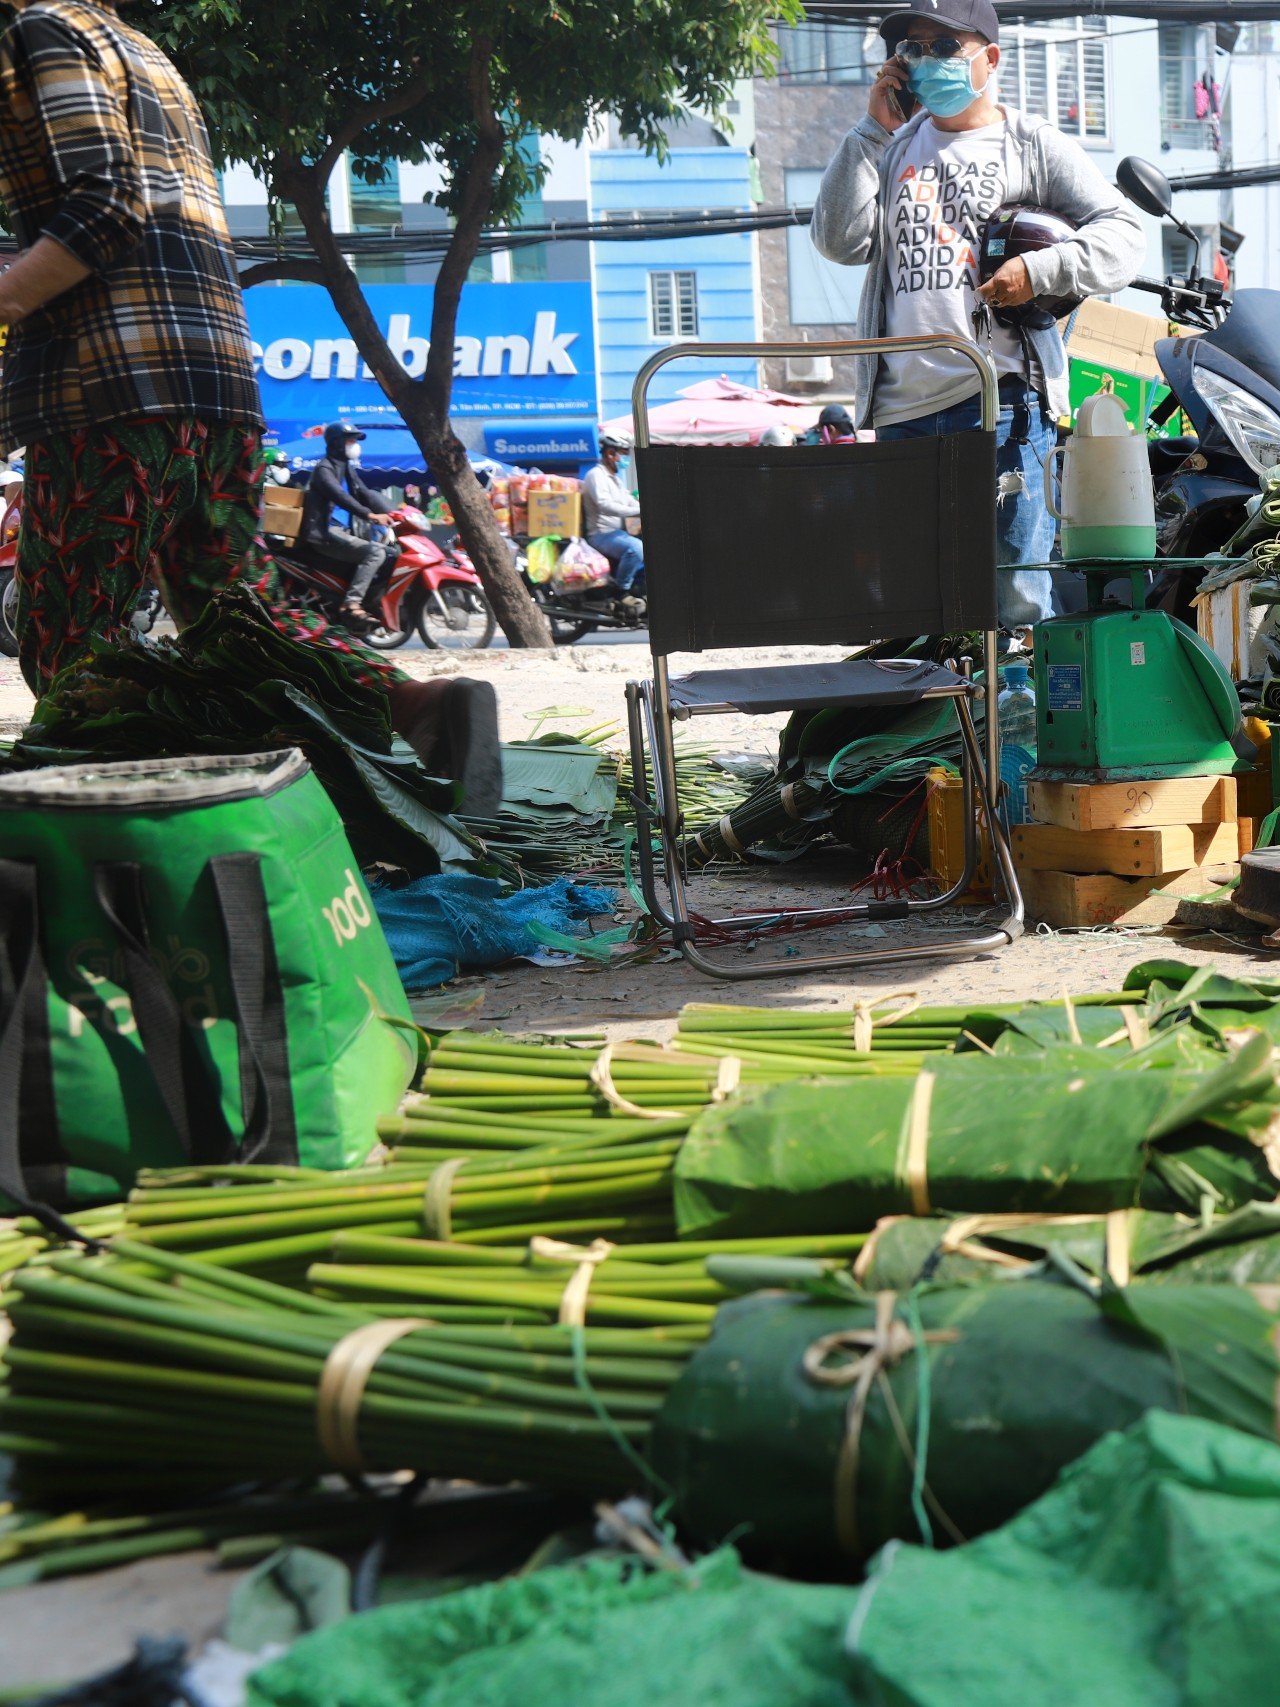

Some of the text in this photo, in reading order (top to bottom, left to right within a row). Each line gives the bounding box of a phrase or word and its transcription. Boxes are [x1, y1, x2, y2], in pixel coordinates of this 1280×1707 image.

[898, 161, 1000, 183] ADIDAS
[896, 179, 996, 204] ADIDAS
[895, 200, 992, 228] ADIDAS
[898, 245, 977, 274] ADIDA
[896, 267, 976, 296] ADIDA
[494, 438, 590, 454] Sacombank
[67, 984, 219, 1038] Fod
